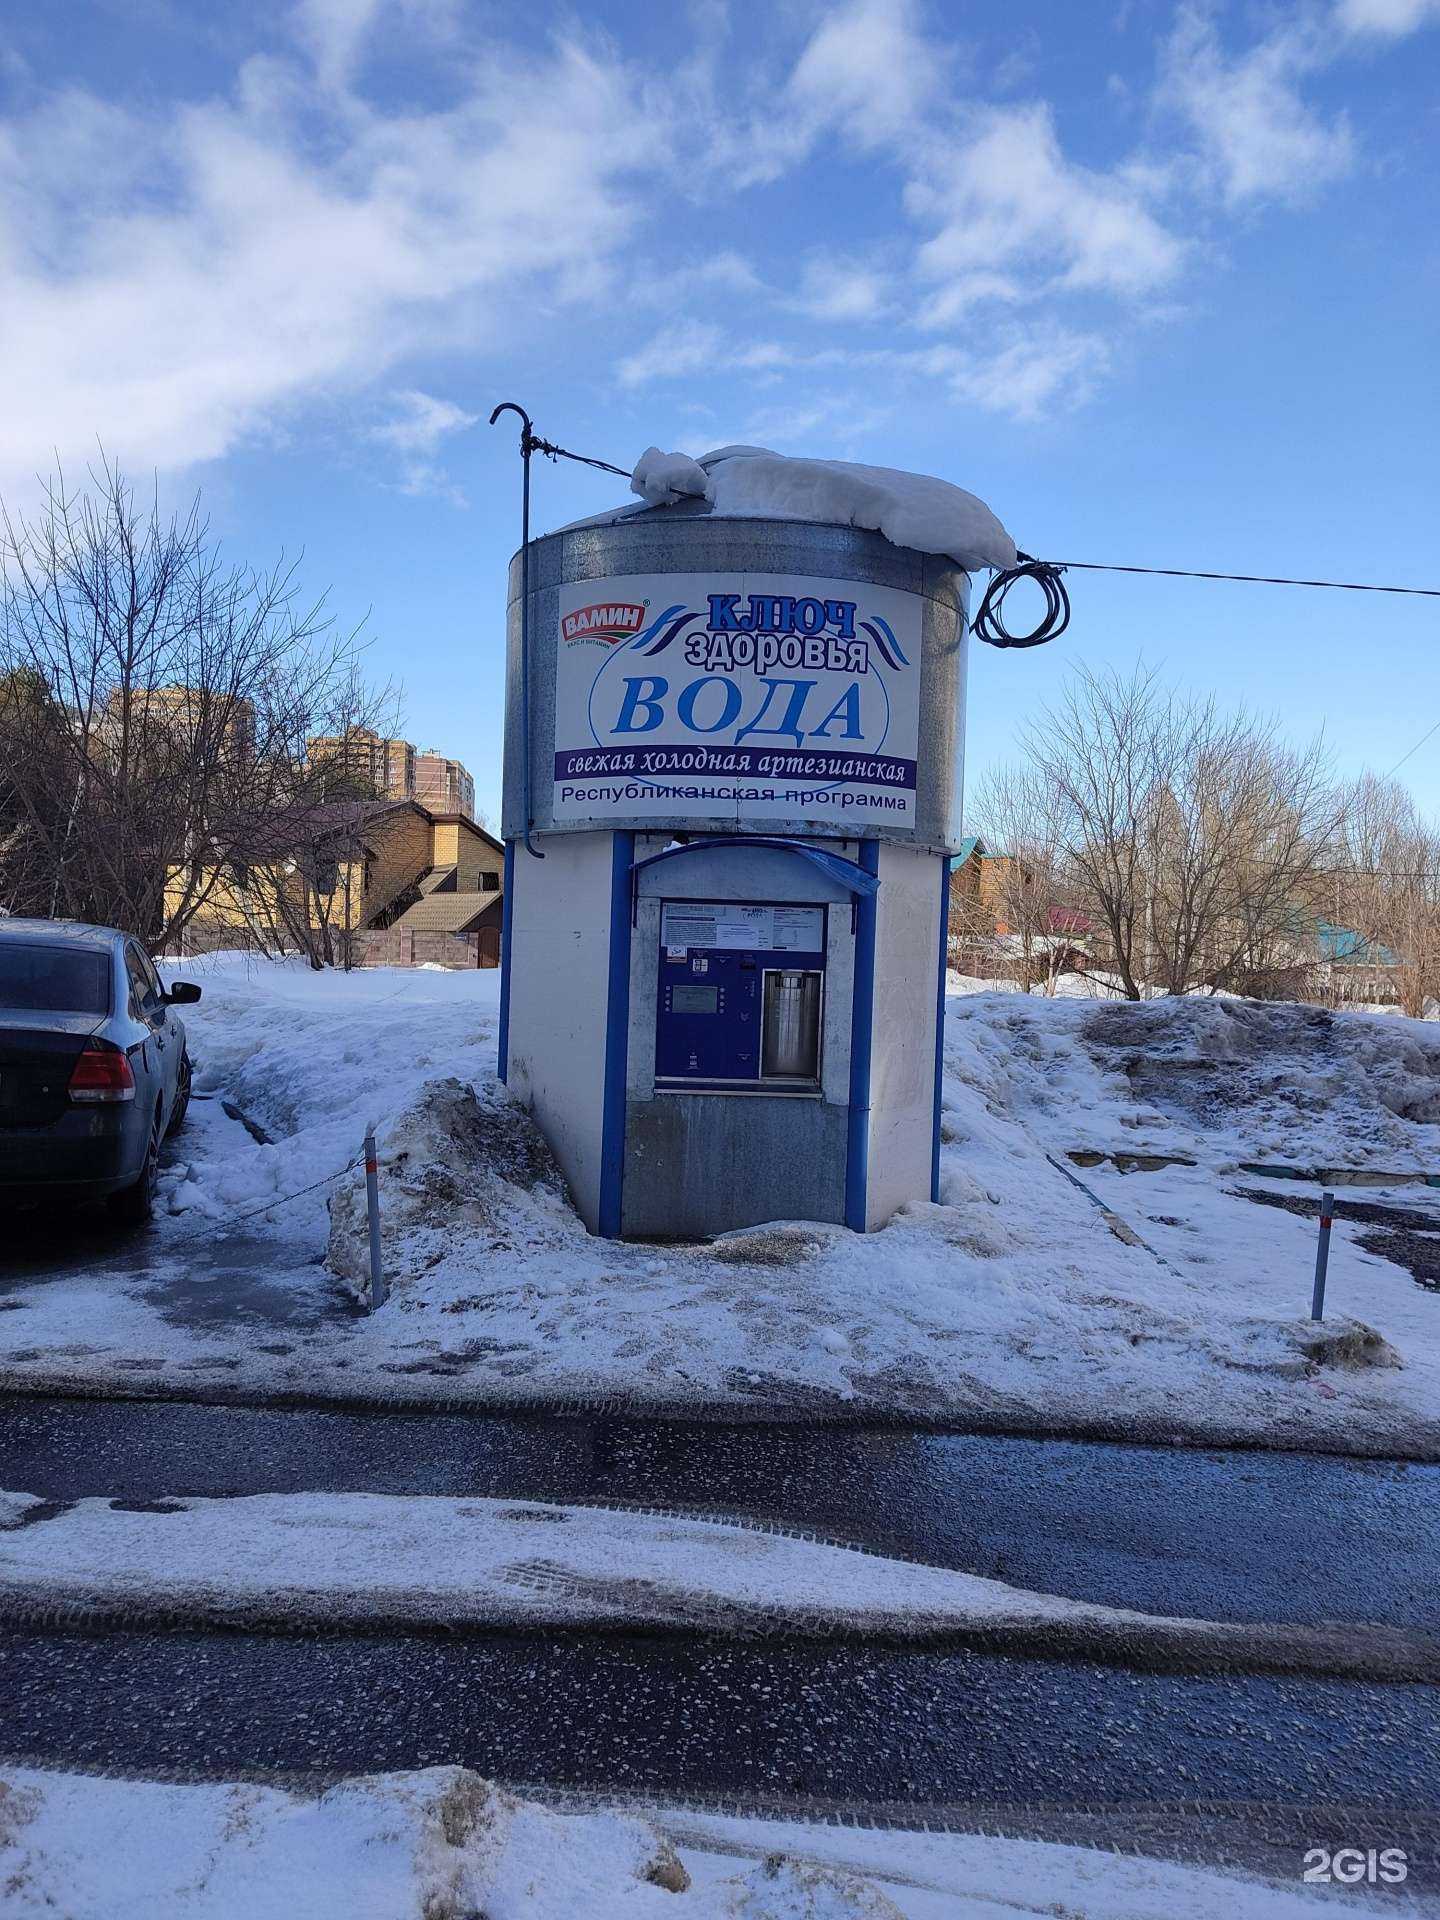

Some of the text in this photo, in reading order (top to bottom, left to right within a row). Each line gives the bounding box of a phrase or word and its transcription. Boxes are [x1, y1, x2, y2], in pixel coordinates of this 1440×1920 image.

[565, 607, 640, 636] ВАМИН
[707, 594, 856, 637] КЛЮЧ
[685, 631, 868, 674] ЗДОРОВЬЯ
[610, 676, 865, 747] ВОДА
[567, 746, 905, 782] свежая холодная артезианская
[561, 783, 906, 810] Республиканская программа
